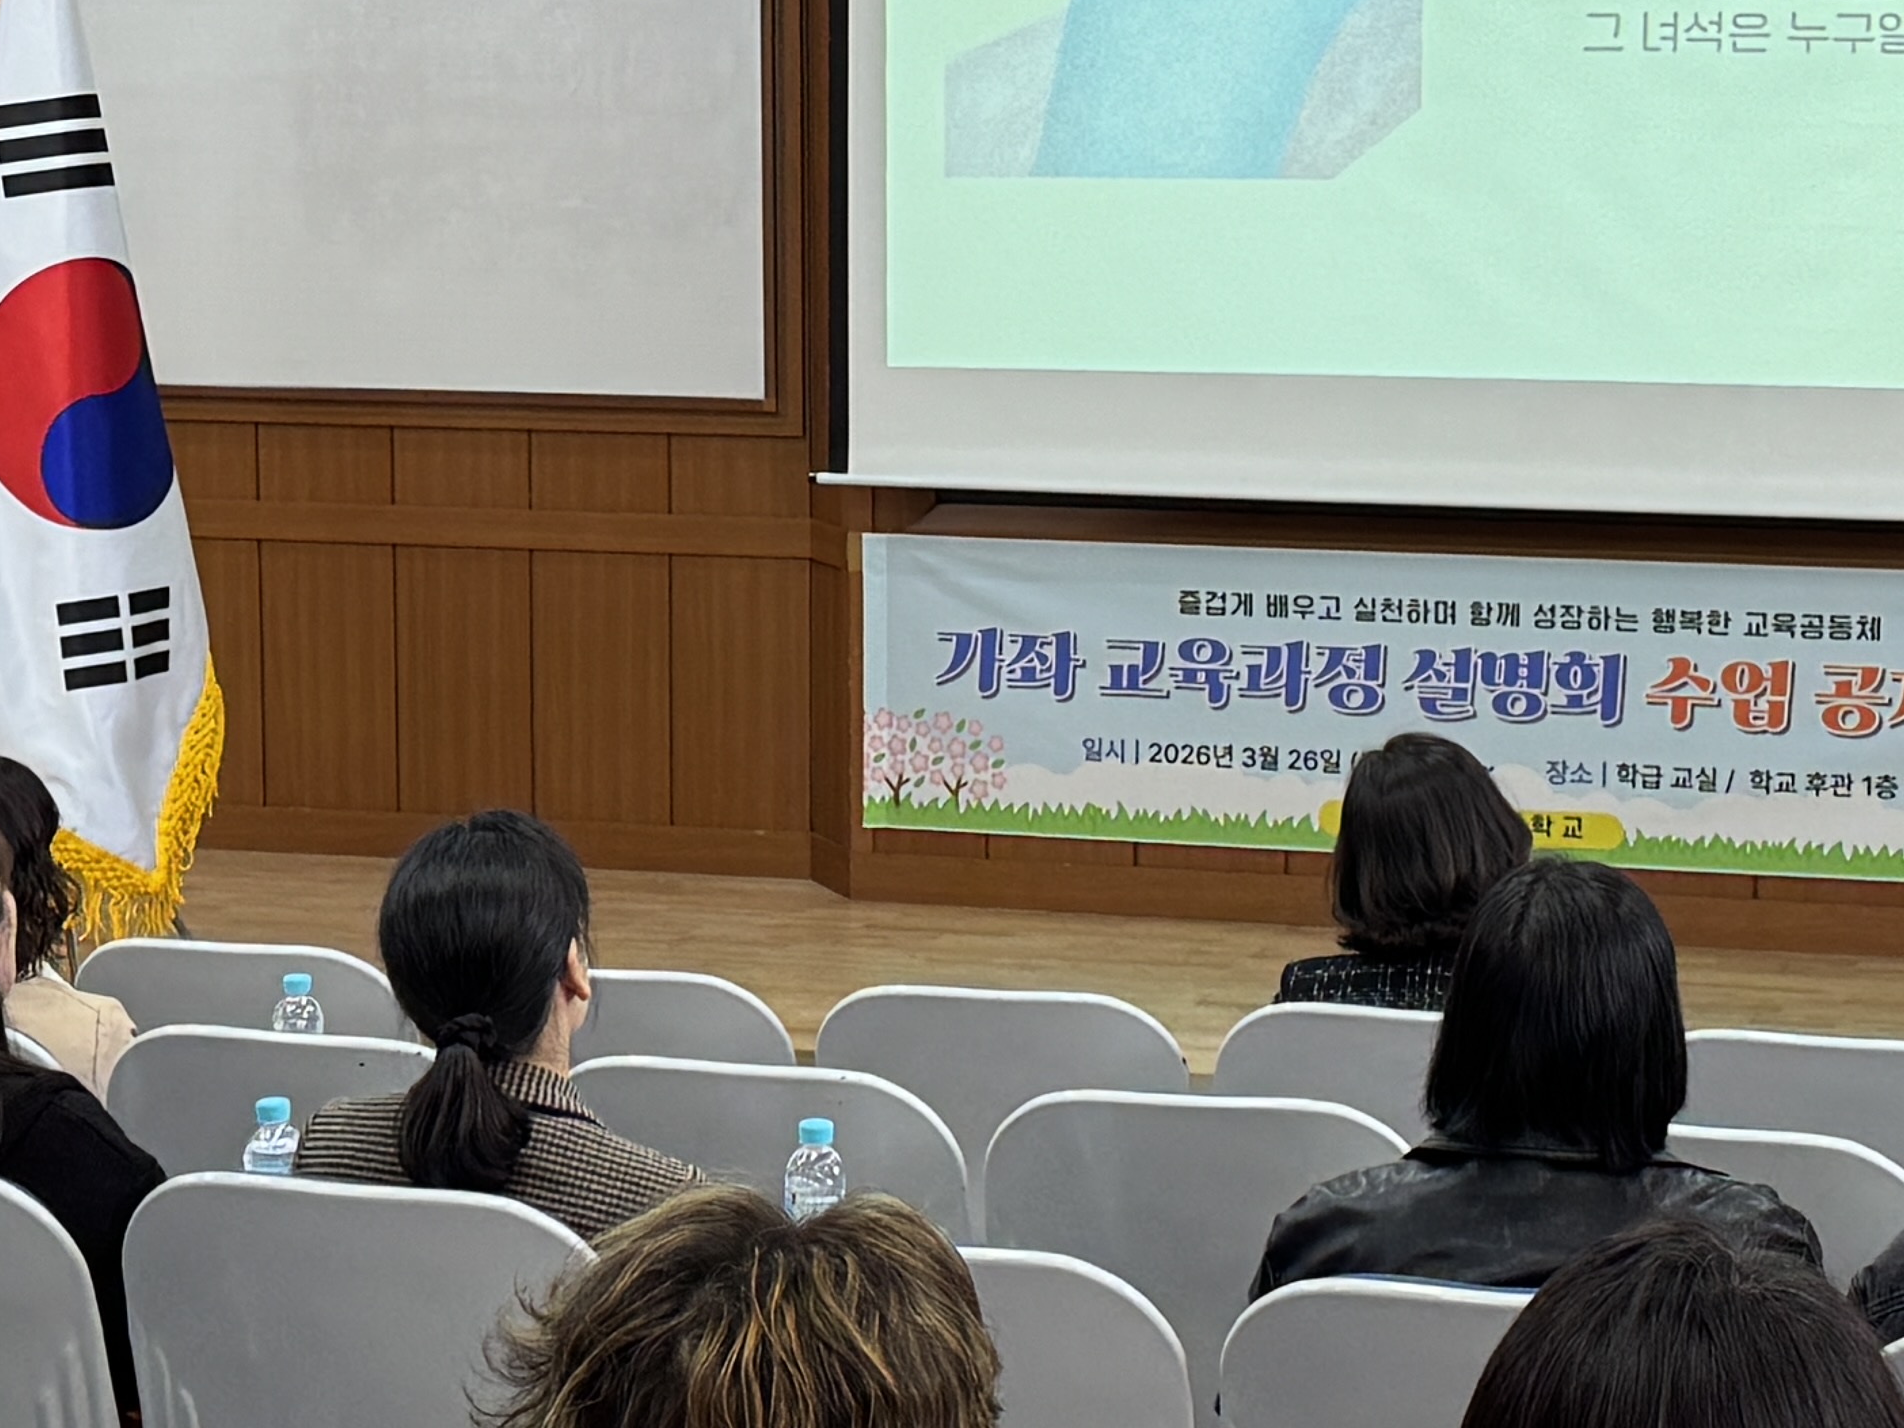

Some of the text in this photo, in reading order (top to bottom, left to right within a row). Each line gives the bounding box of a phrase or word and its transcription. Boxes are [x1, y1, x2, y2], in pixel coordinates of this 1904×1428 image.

[1583, 12, 1624, 52] 그
[1642, 10, 1771, 53] 녀석은
[1178, 590, 1882, 642] 즐겁게 배우고 실천하며 함께 성장하는 행복한 교육공동체
[934, 626, 1086, 703] 가좌
[1097, 634, 1389, 717] 교육과정
[1401, 643, 1628, 727] 설명회
[1643, 653, 1795, 736] 수업
[1082, 736, 1126, 763] 일시
[1148, 742, 1234, 769] 2026년
[1241, 745, 1280, 772] 3월
[1287, 748, 1342, 774] 26일
[1546, 759, 1594, 786] 장소
[1616, 762, 1663, 790] 학급
[1670, 765, 1718, 794] 교실
[1749, 769, 1798, 795] 학교
[1805, 772, 1854, 798] 후관
[1862, 774, 1899, 800] 1층
